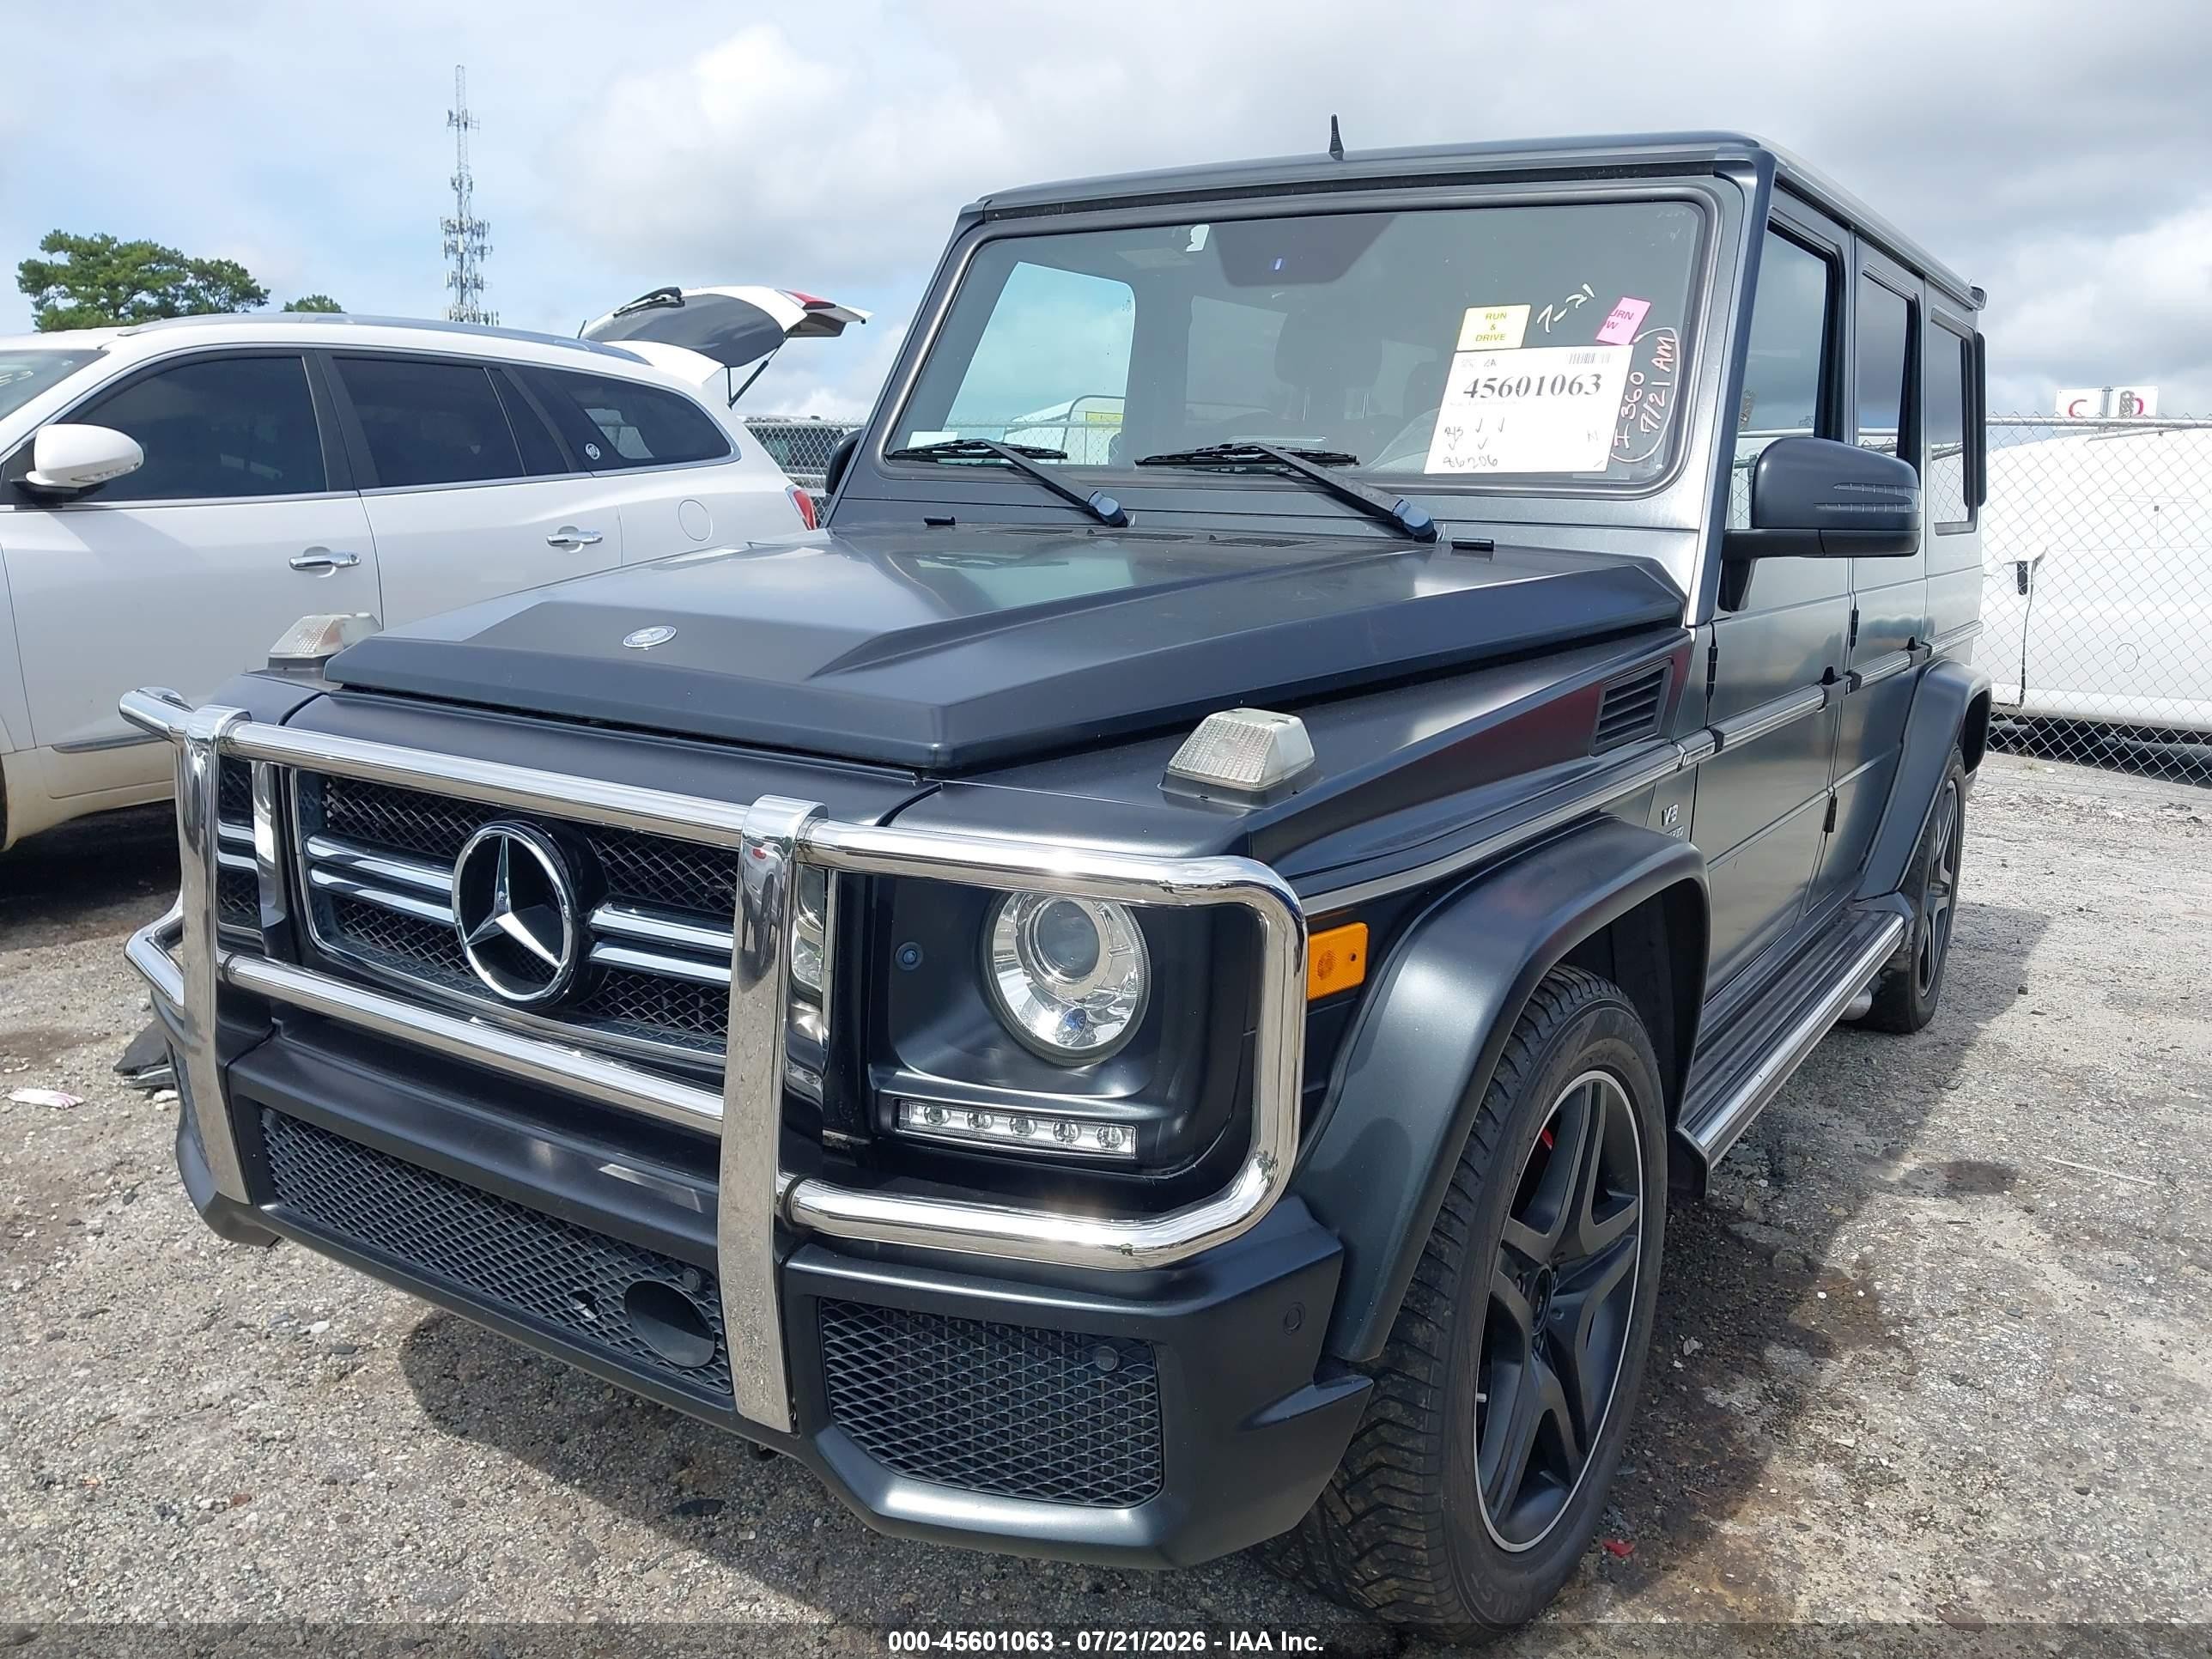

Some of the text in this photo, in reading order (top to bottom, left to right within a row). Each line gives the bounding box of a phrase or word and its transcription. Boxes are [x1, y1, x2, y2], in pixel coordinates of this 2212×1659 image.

[1475, 333, 1506, 342] DRIVE
[1463, 374, 1601, 398] 45601063
[1640, 336, 1675, 435] 7/21 AM
[1662, 804, 1679, 826] V8
